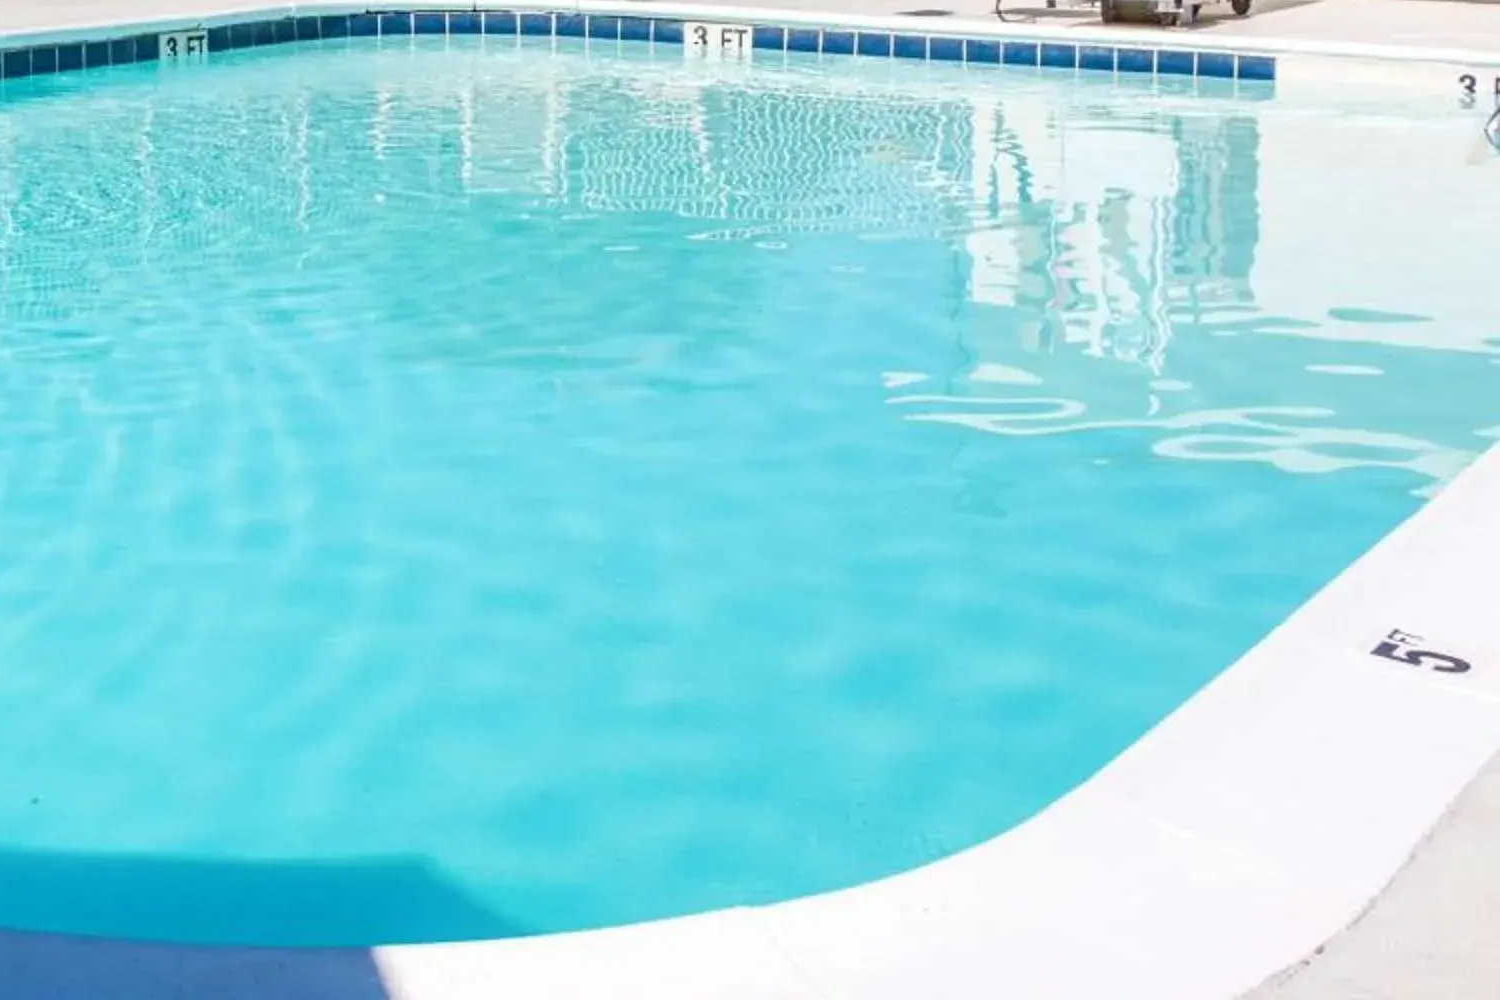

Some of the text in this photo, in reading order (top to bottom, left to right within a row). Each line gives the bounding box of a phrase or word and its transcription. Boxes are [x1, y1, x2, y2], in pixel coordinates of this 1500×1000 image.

[166, 35, 205, 57] 3 FT
[693, 25, 748, 48] 3 FT
[1369, 641, 1471, 673] 5
